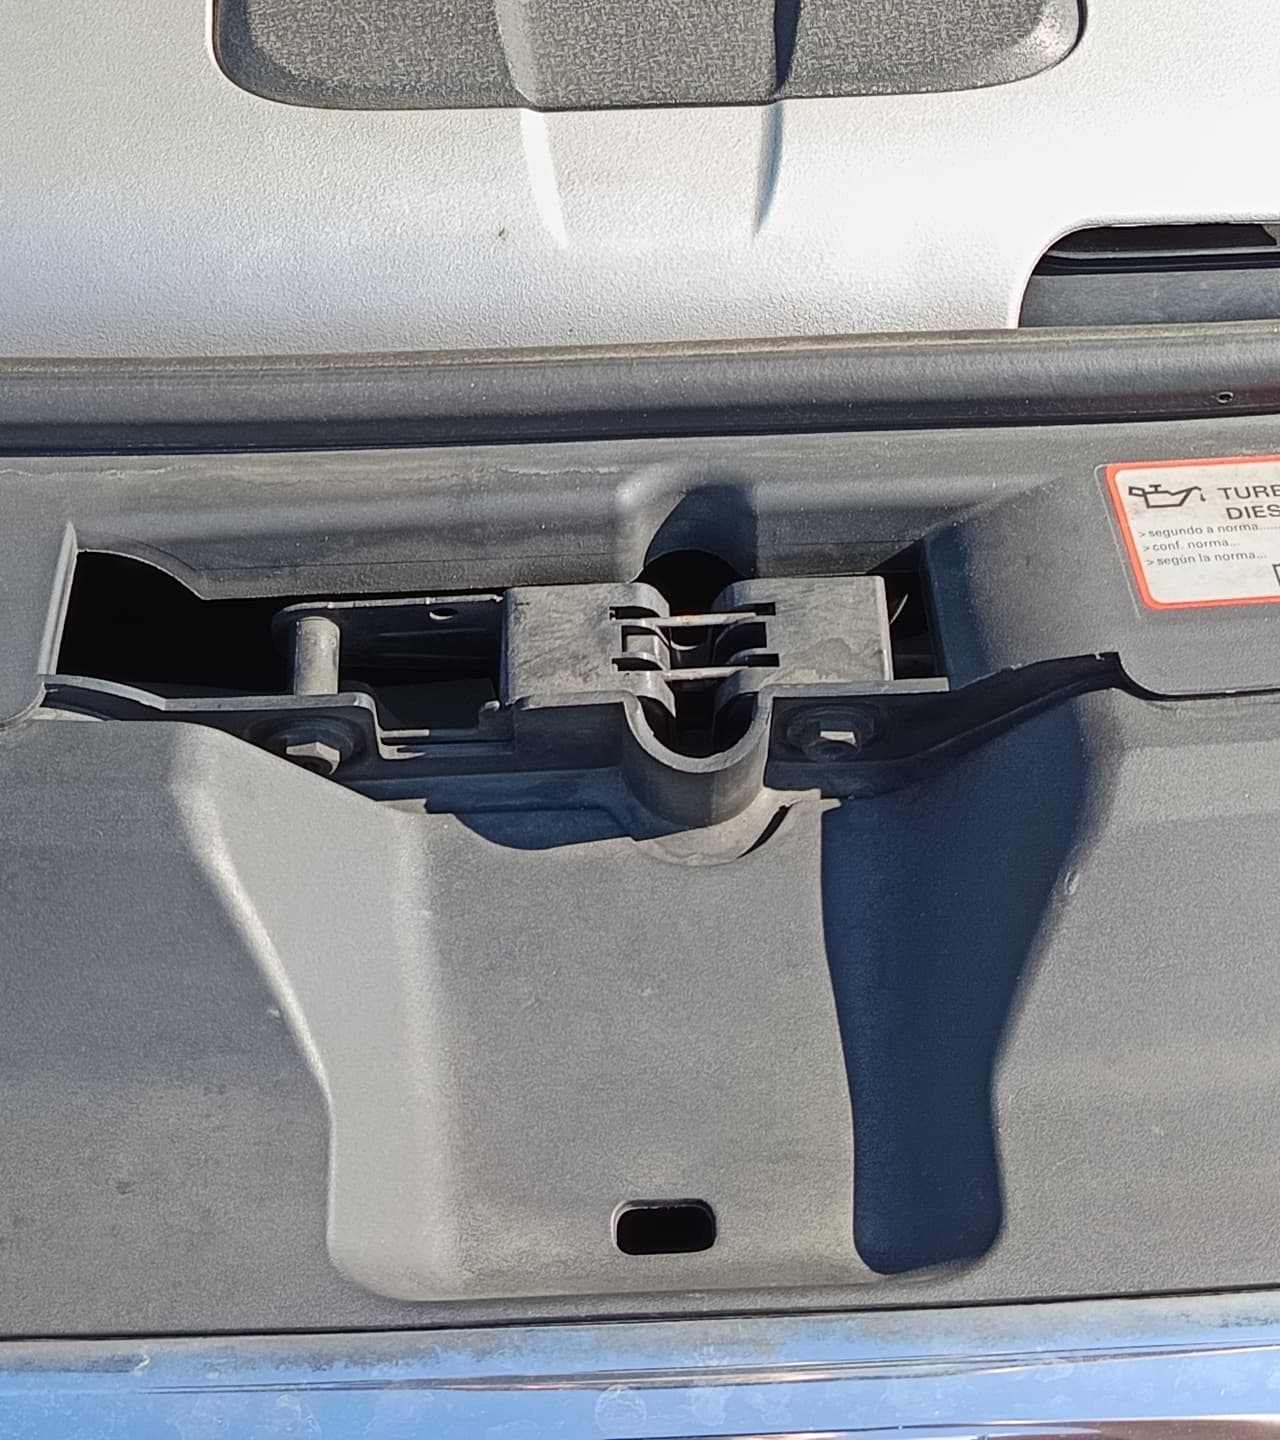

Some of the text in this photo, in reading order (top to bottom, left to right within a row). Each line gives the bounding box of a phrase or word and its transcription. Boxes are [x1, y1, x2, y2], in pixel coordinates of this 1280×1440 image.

[1148, 526, 1203, 539] segundo
[1152, 541, 1184, 552] conf.
[1157, 556, 1196, 567] según
[1198, 553, 1211, 563] la
